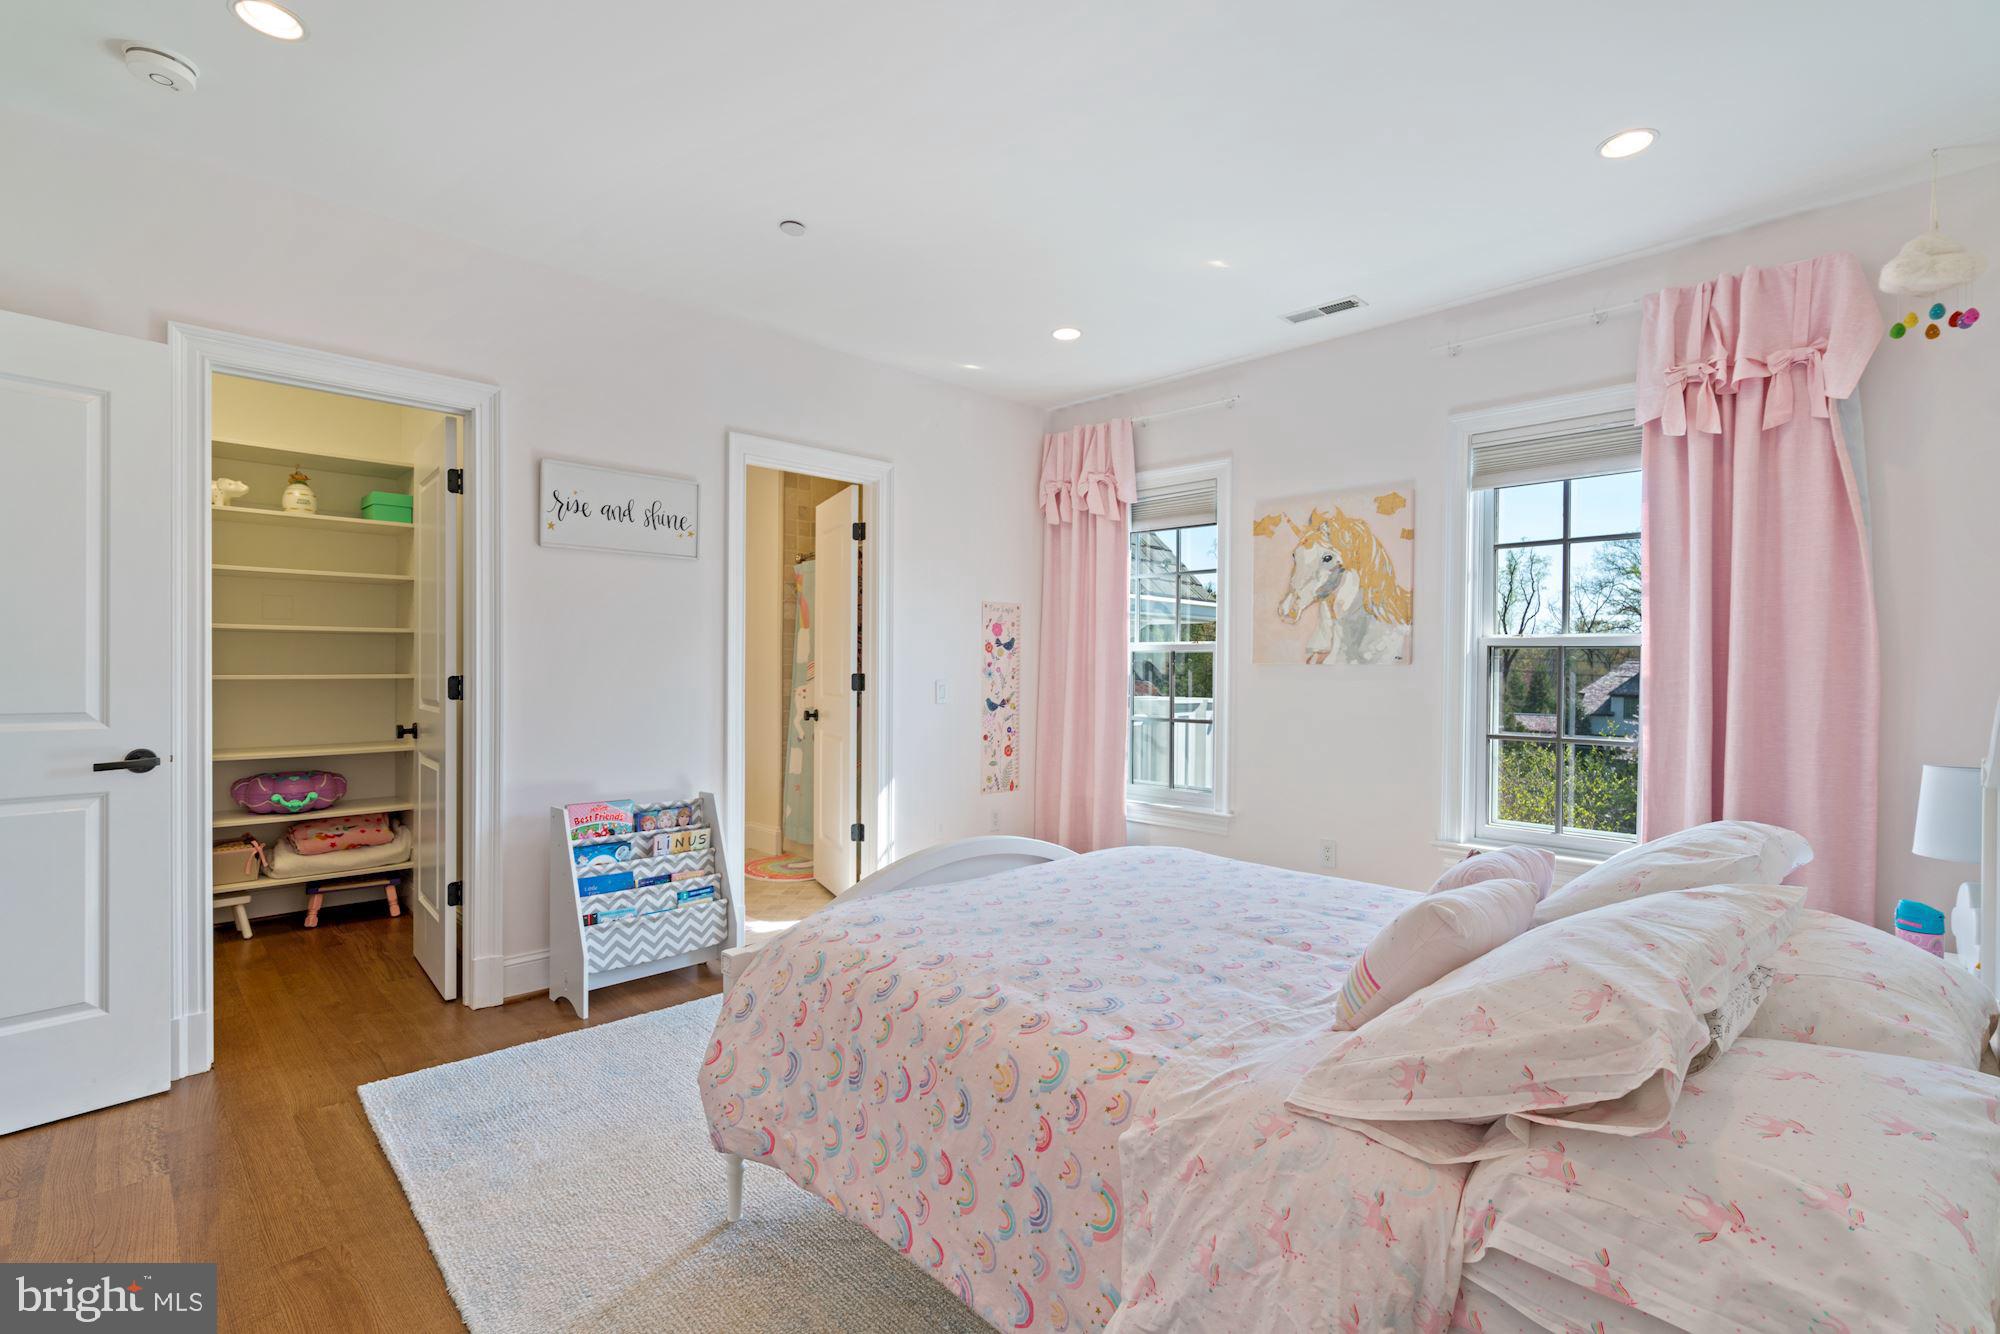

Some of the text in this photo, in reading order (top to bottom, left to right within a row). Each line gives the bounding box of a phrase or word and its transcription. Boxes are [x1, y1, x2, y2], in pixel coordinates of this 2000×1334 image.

[547, 489, 693, 532] rise and shine
[574, 811, 625, 826] Best Friends
